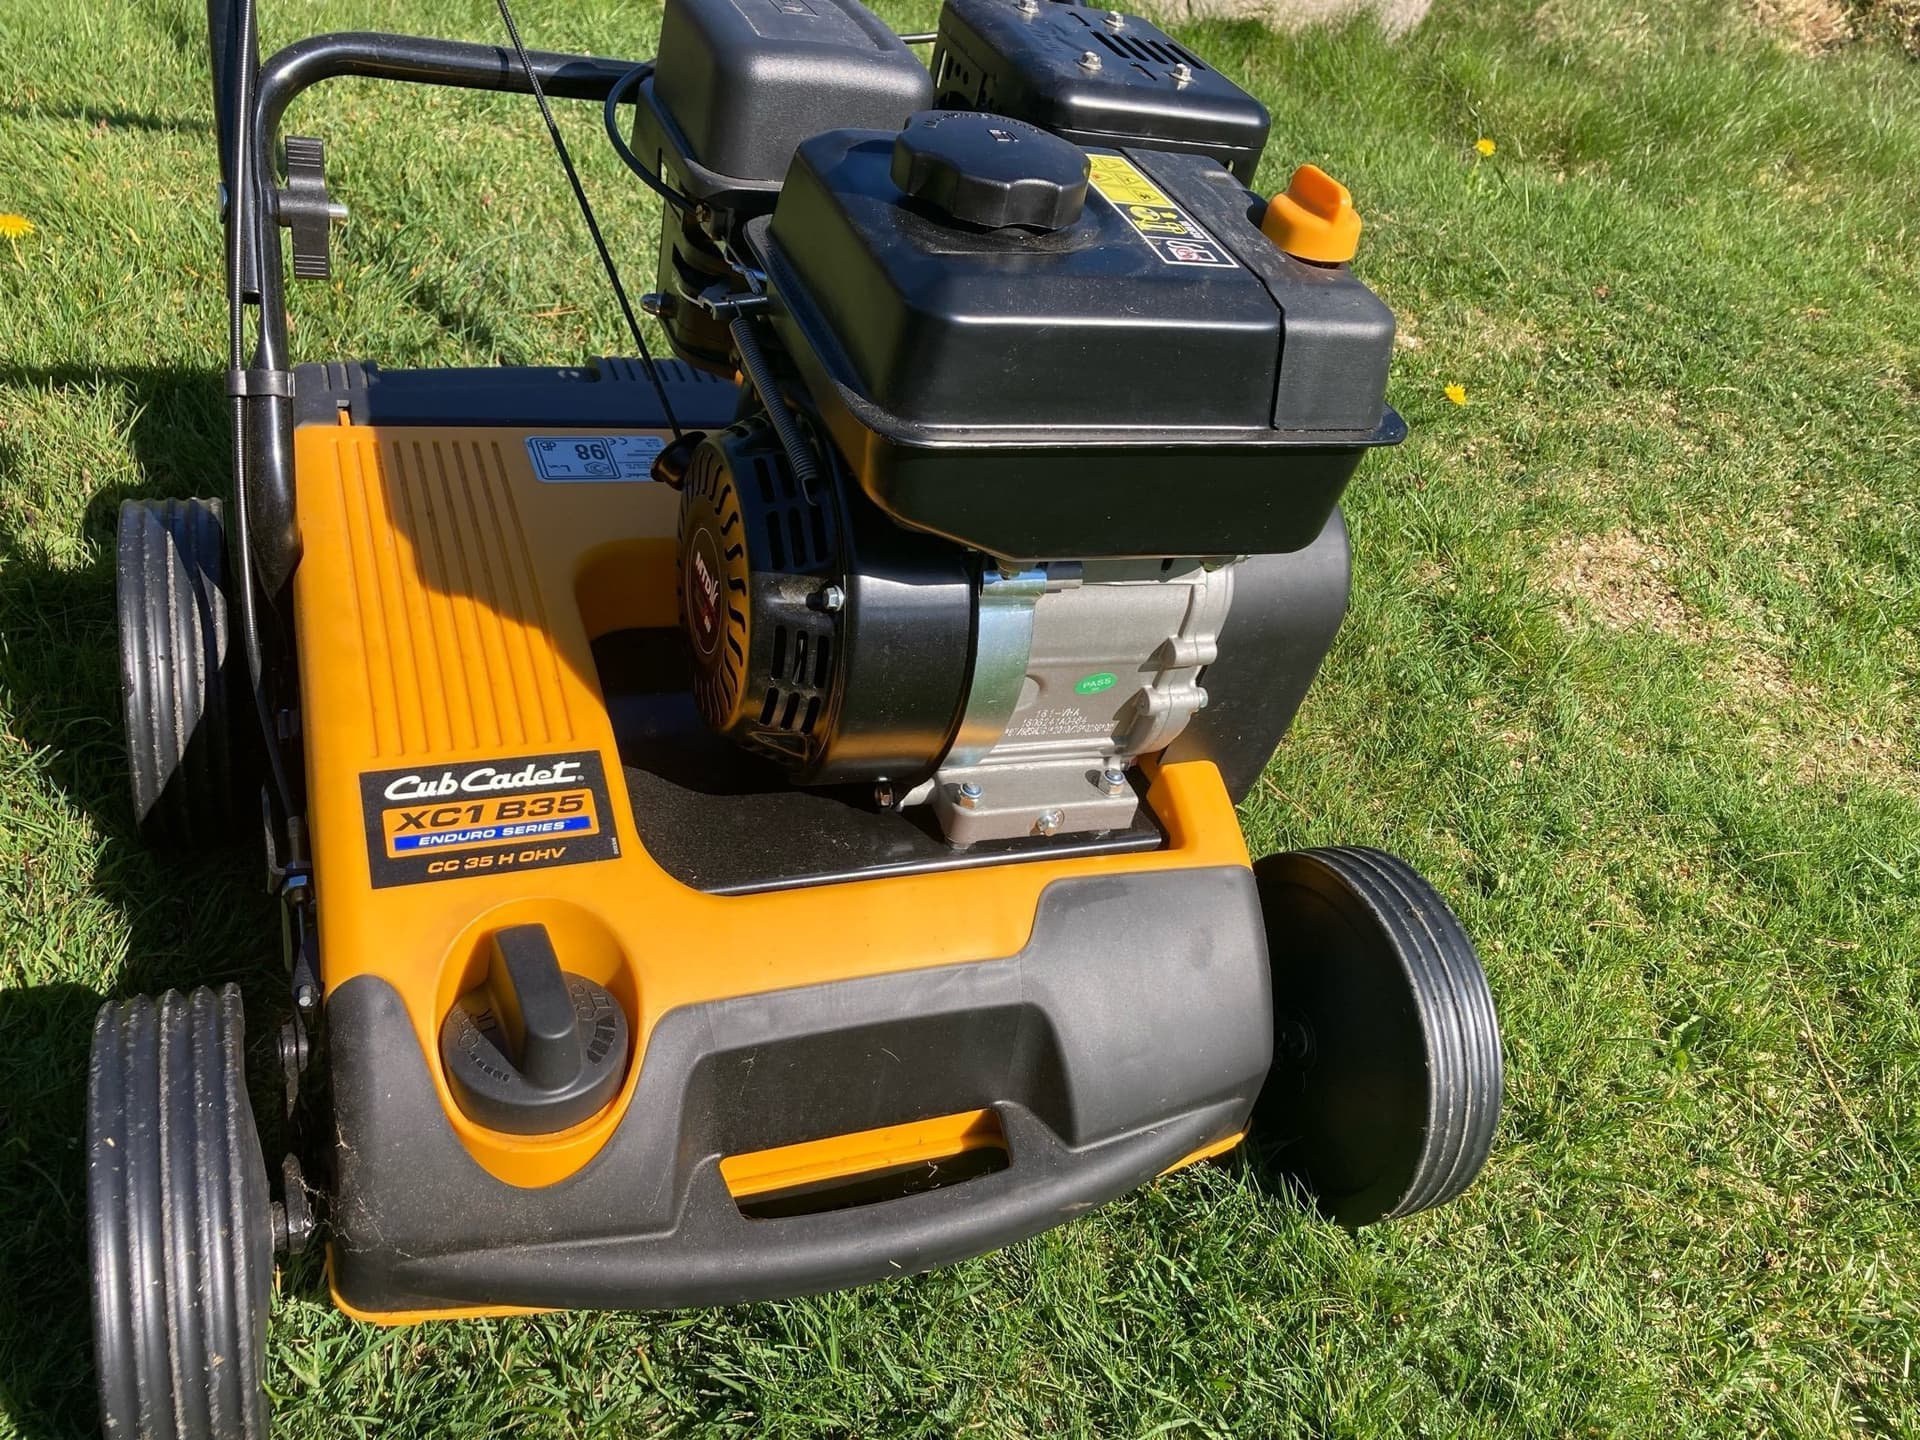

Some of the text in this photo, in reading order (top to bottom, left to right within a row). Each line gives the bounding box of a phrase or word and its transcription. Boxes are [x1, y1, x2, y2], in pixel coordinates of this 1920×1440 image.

[574, 443, 605, 460] 98
[1083, 677, 1111, 689] PASS
[384, 761, 582, 800] Cub Cadet
[394, 794, 585, 832] XC1 B35
[418, 821, 565, 846] ENDURO SERIES
[427, 847, 567, 874] CC 35 H OHV
